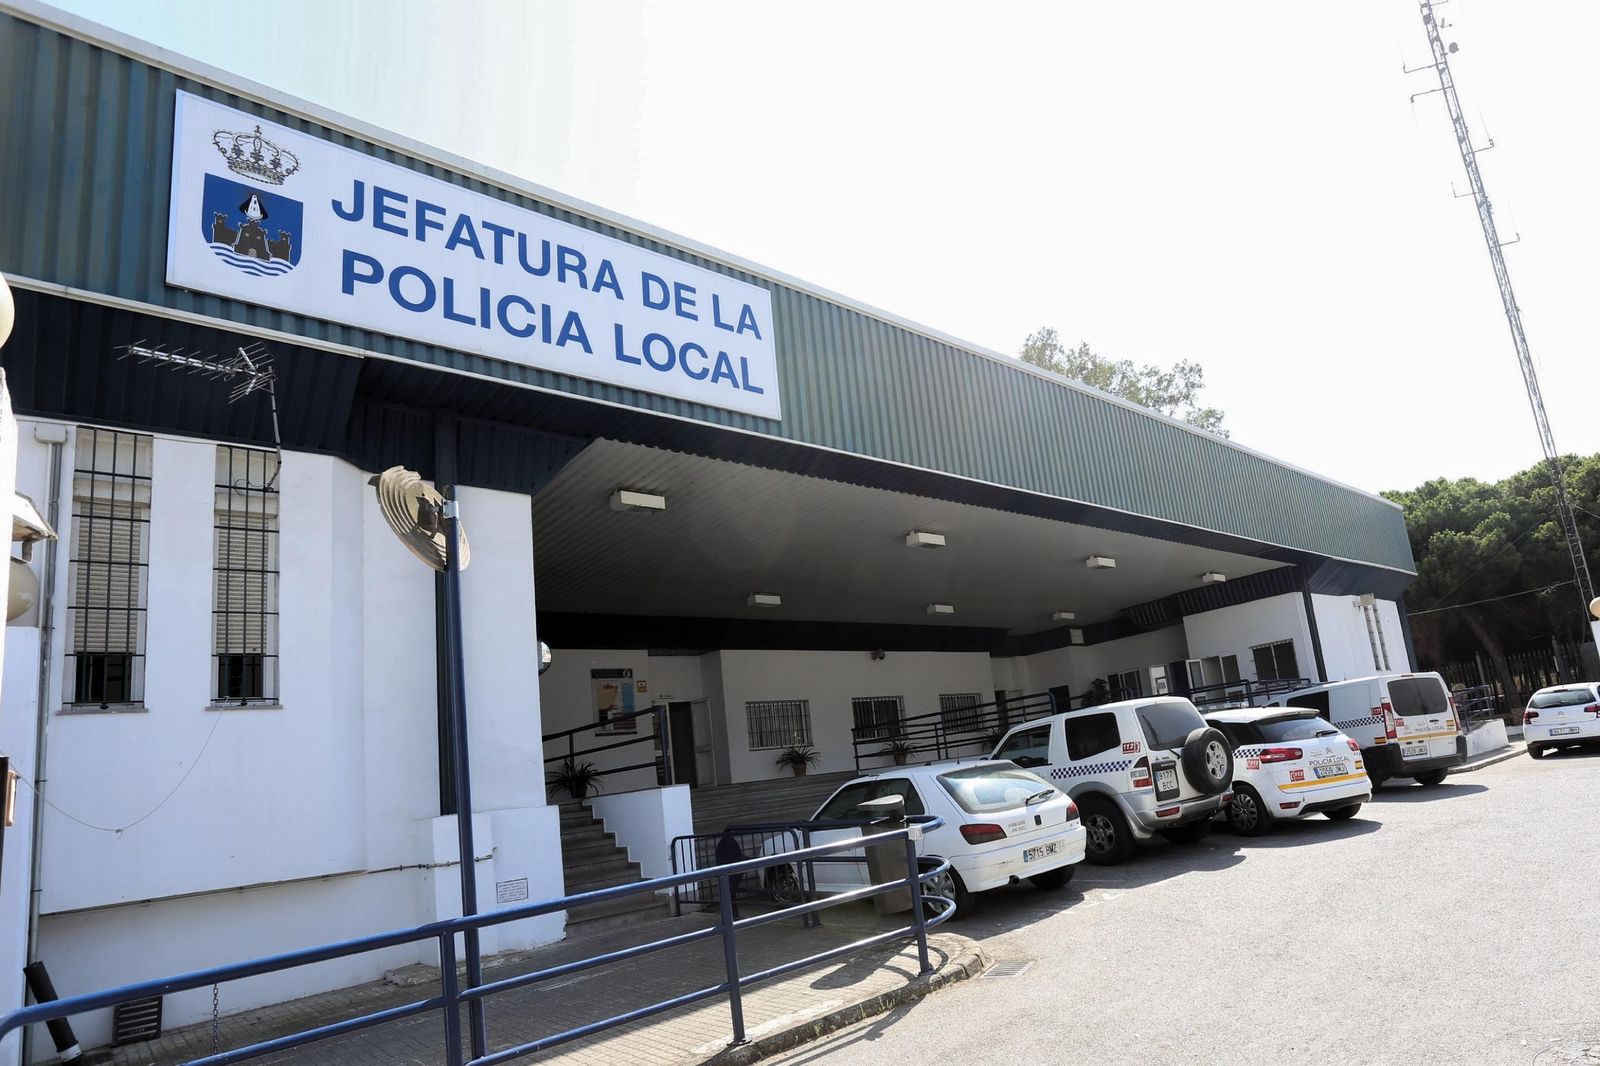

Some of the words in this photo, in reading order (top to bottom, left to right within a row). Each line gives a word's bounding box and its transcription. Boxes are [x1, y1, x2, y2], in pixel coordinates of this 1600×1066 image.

[332, 179, 624, 300] JEFATURA
[641, 271, 698, 321] DE
[712, 294, 762, 340] LA
[342, 249, 593, 354] POLICIA
[614, 323, 764, 395] LOCAL
[1123, 743, 1134, 751] 112
[1309, 757, 1333, 767] POLICIA
[1333, 755, 1350, 763] LOCAL
[1028, 847, 1044, 860] 5715
